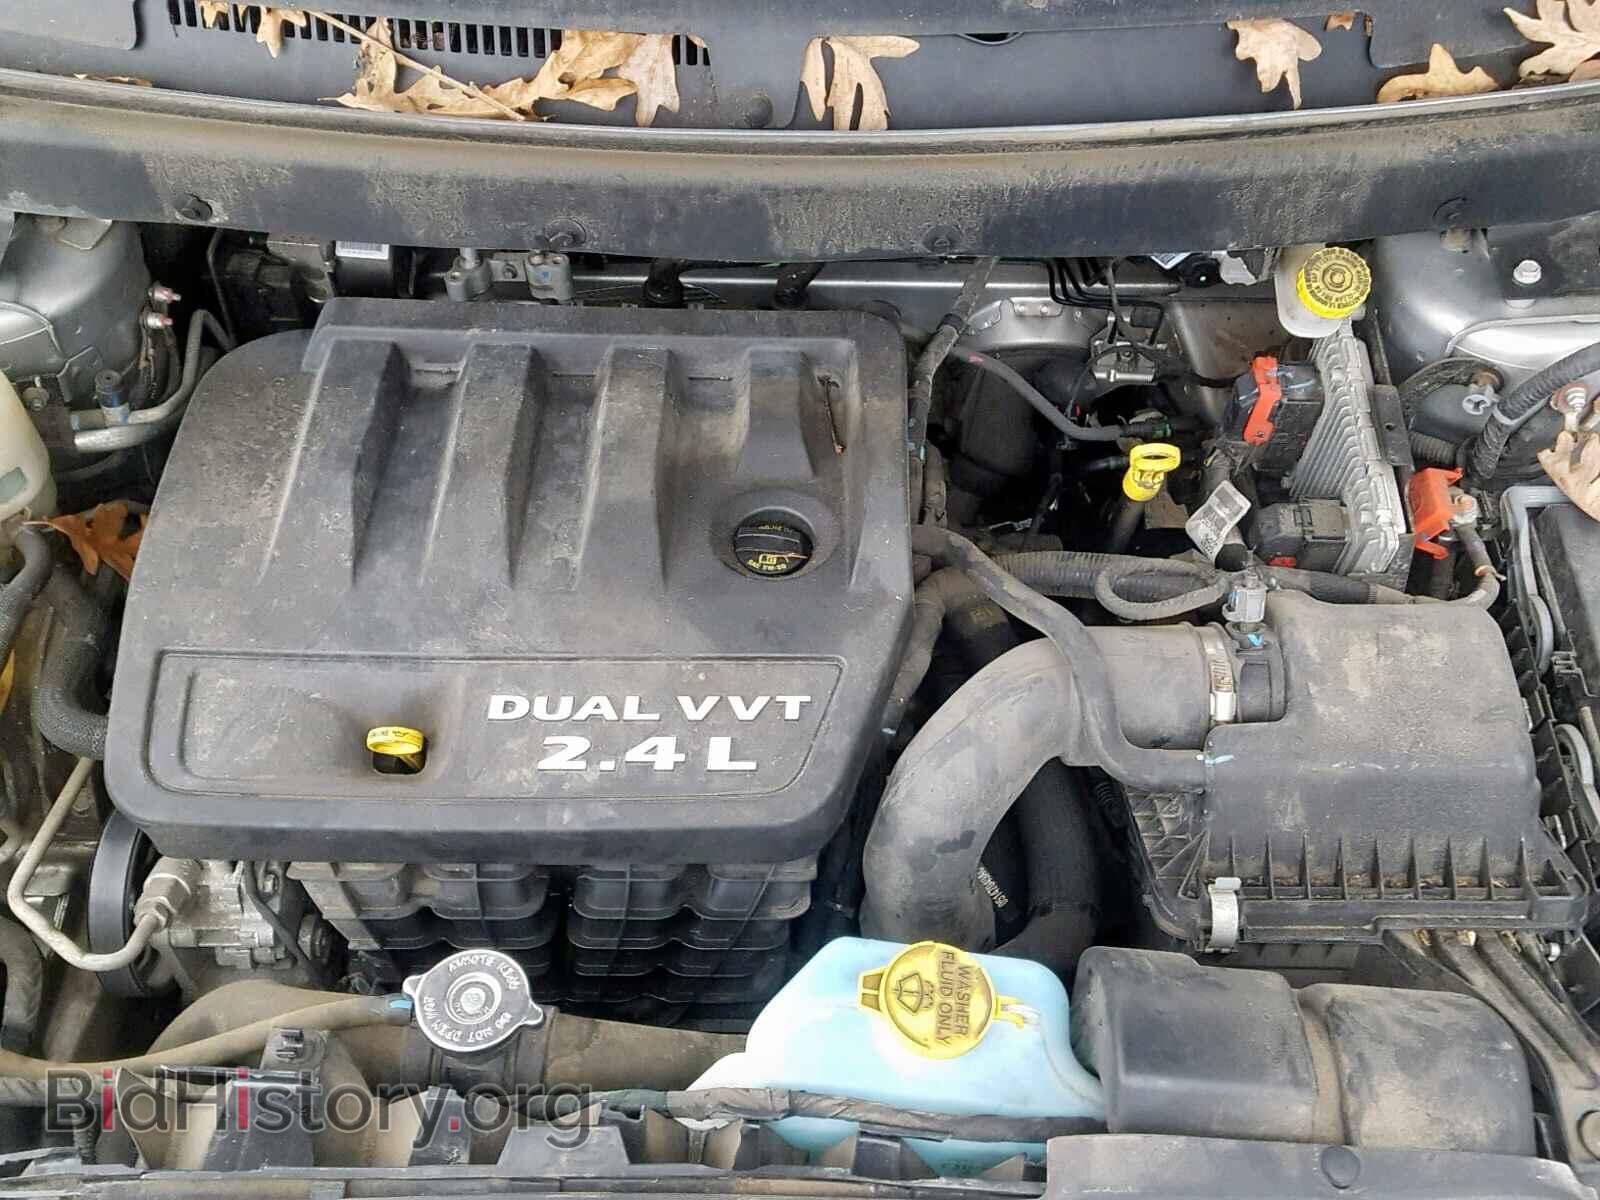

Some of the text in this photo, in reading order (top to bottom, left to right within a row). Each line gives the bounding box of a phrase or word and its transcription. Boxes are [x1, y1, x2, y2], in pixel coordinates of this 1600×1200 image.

[488, 695, 812, 721] DUAL VVT
[936, 951, 954, 1045] FLUID ONLY
[953, 964, 972, 1036] WASHER
[467, 1026, 494, 1042] NOT
